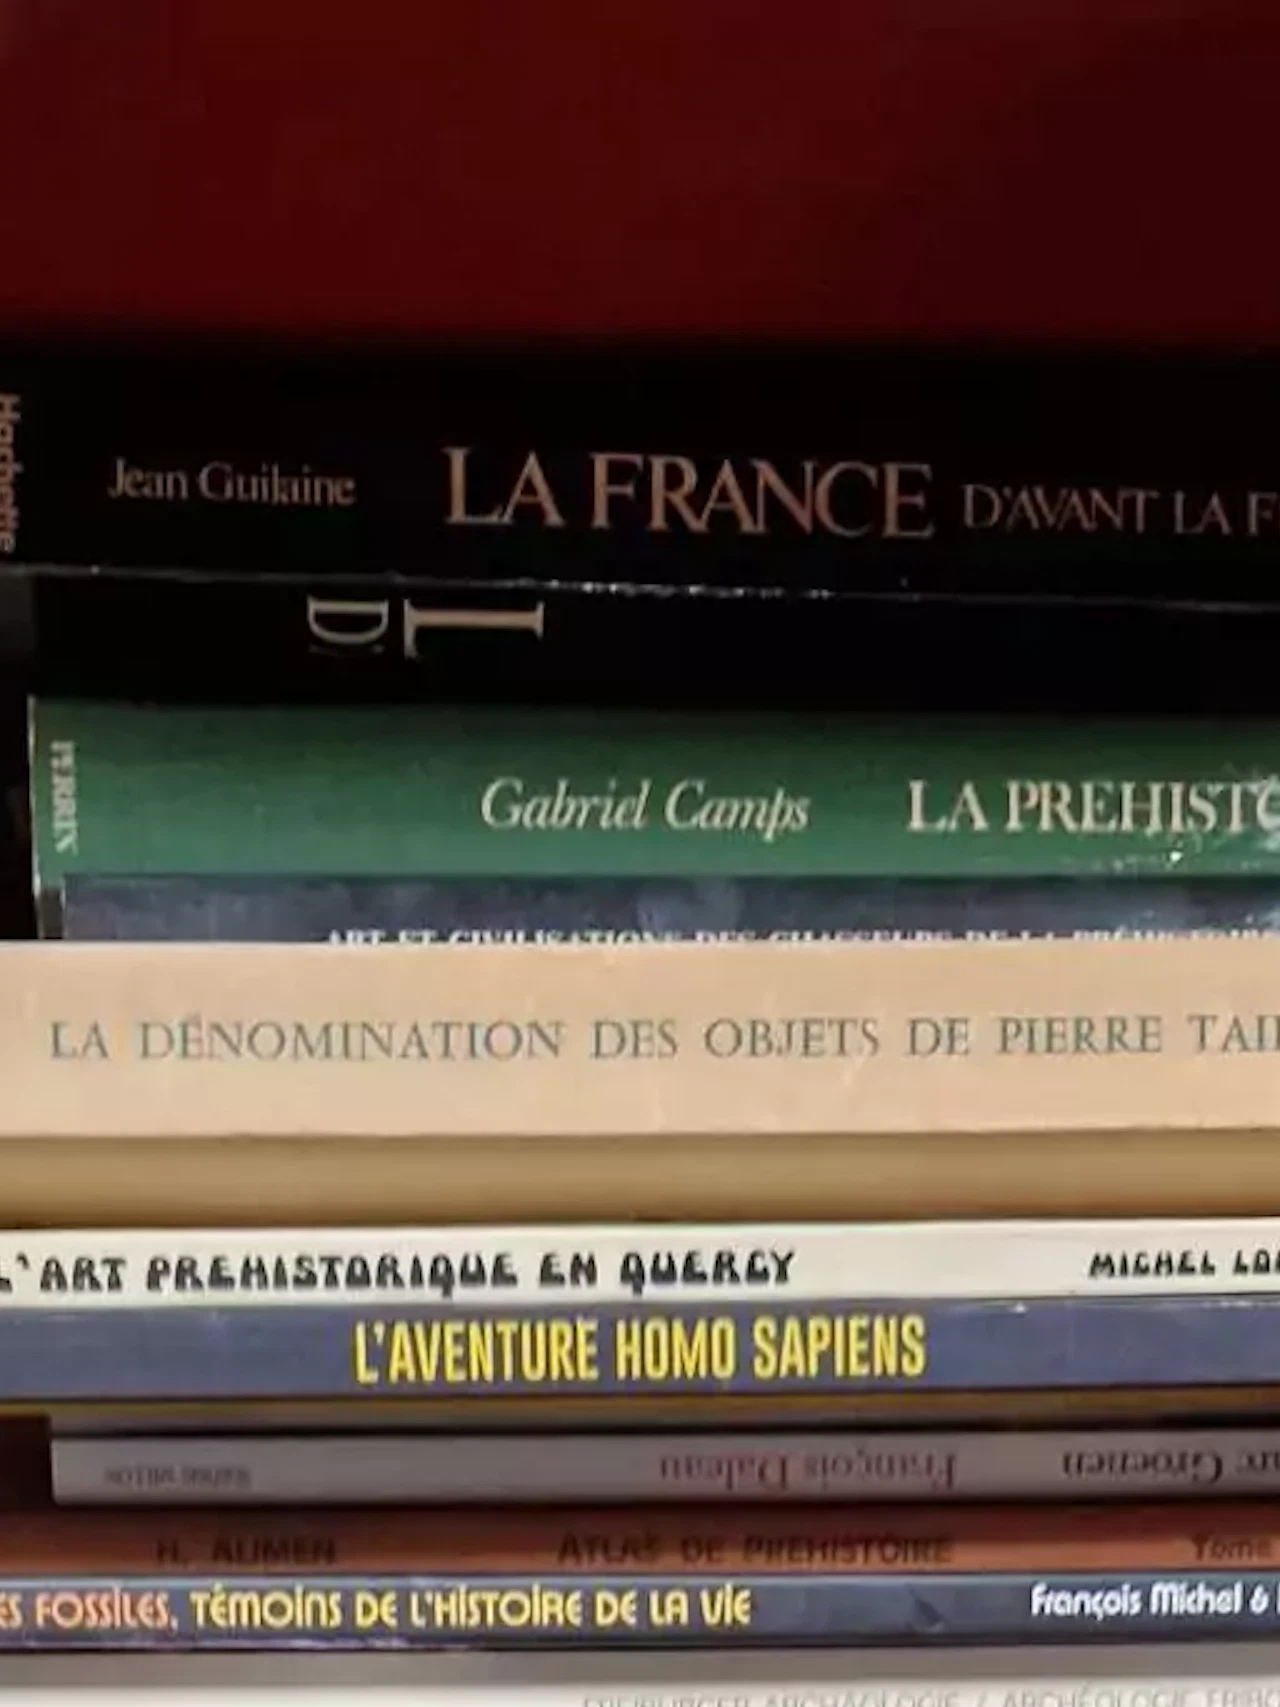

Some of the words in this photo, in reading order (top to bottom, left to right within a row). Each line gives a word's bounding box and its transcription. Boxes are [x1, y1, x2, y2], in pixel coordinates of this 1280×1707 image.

[108, 458, 188, 500] Jean
[199, 462, 357, 506] Guilaine
[443, 446, 565, 527] LA
[591, 452, 934, 540] FRANCE
[963, 483, 1158, 531] D'AVANT
[1174, 491, 1231, 536] LA
[480, 777, 652, 831] Gabriel
[665, 780, 809, 841] Camps
[909, 780, 989, 832] LA
[50, 1021, 110, 1062] LA
[141, 1013, 564, 1062] DÉNOMINATION
[590, 1020, 677, 1061] DES
[705, 1016, 881, 1059] OBJETS
[908, 1017, 970, 1057] DE
[998, 1014, 1162, 1055] PIERRE
[147, 1251, 518, 1298] PREHISTORIQUE
[540, 1252, 598, 1288] EN
[1089, 1247, 1216, 1279] MICHEL
[354, 1318, 600, 1385] L'AVENTURE
[617, 1316, 734, 1381] HOMO
[753, 1313, 927, 1379] SAPIENS
[803, 1449, 958, 1491] François
[558, 1534, 658, 1564] ATLAS
[681, 1536, 720, 1563] DE
[1191, 1535, 1271, 1558] Tome
[355, 1590, 397, 1626] DE
[596, 1590, 636, 1627] DE
[650, 1590, 688, 1627] LA
[1032, 1586, 1142, 1618] François
[1150, 1585, 1243, 1616] Michel
